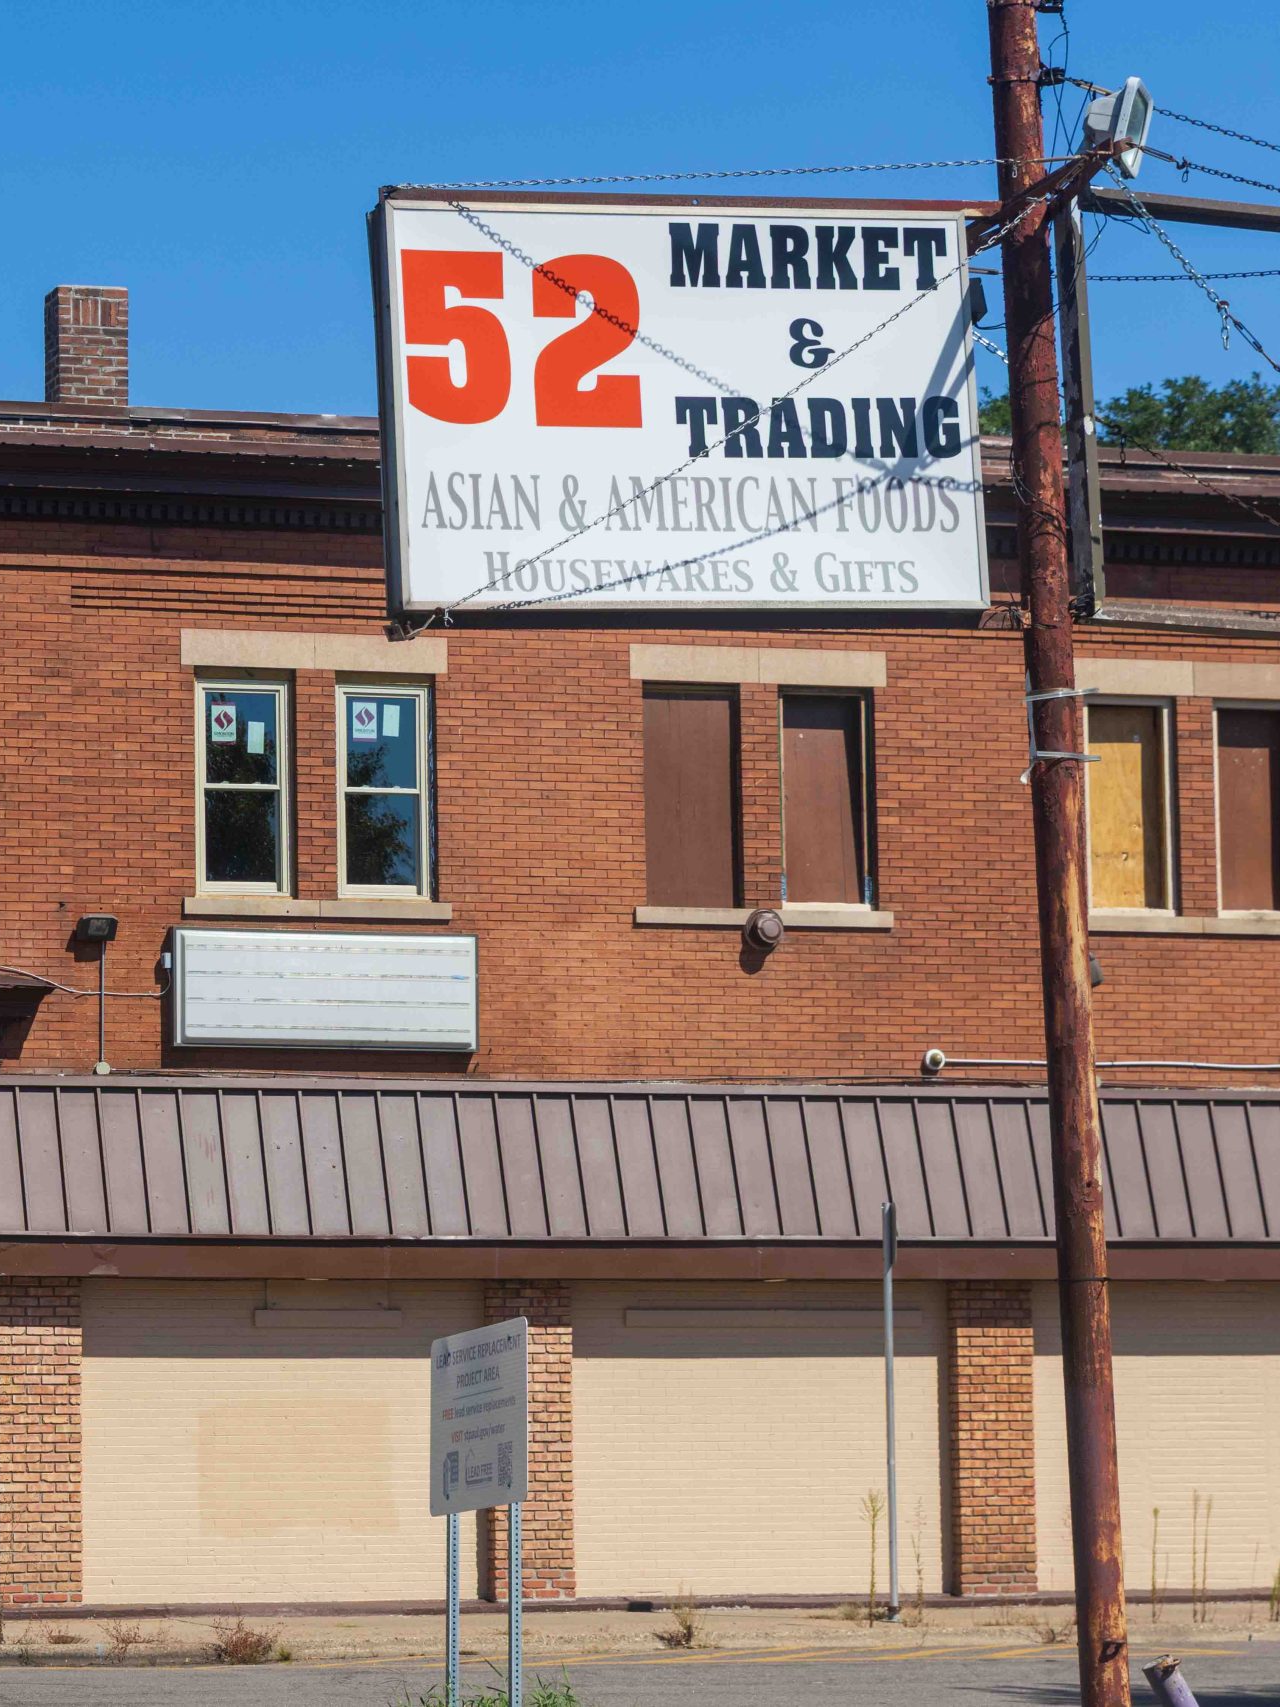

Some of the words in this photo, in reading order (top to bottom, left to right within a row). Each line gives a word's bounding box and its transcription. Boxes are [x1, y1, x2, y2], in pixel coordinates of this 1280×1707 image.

[668, 222, 947, 292] MARKET
[400, 248, 642, 428] 52
[789, 318, 836, 369] &
[675, 395, 962, 459] TRADING
[421, 470, 541, 533] ASIAN
[559, 474, 589, 534] &
[605, 474, 818, 534] AMERICAN
[836, 475, 961, 535] FOODS
[770, 551, 798, 594] &
[452, 1345, 476, 1366] SERVICE
[477, 1334, 521, 1359] REPLACEMENT
[457, 1369, 482, 1389] PROJECT
[484, 1366, 500, 1382] AREA
[443, 1408, 454, 1421] FREE
[452, 1430, 463, 1443] VISIT
[467, 1464, 480, 1479] LEAD
[481, 1462, 493, 1476] FREE
